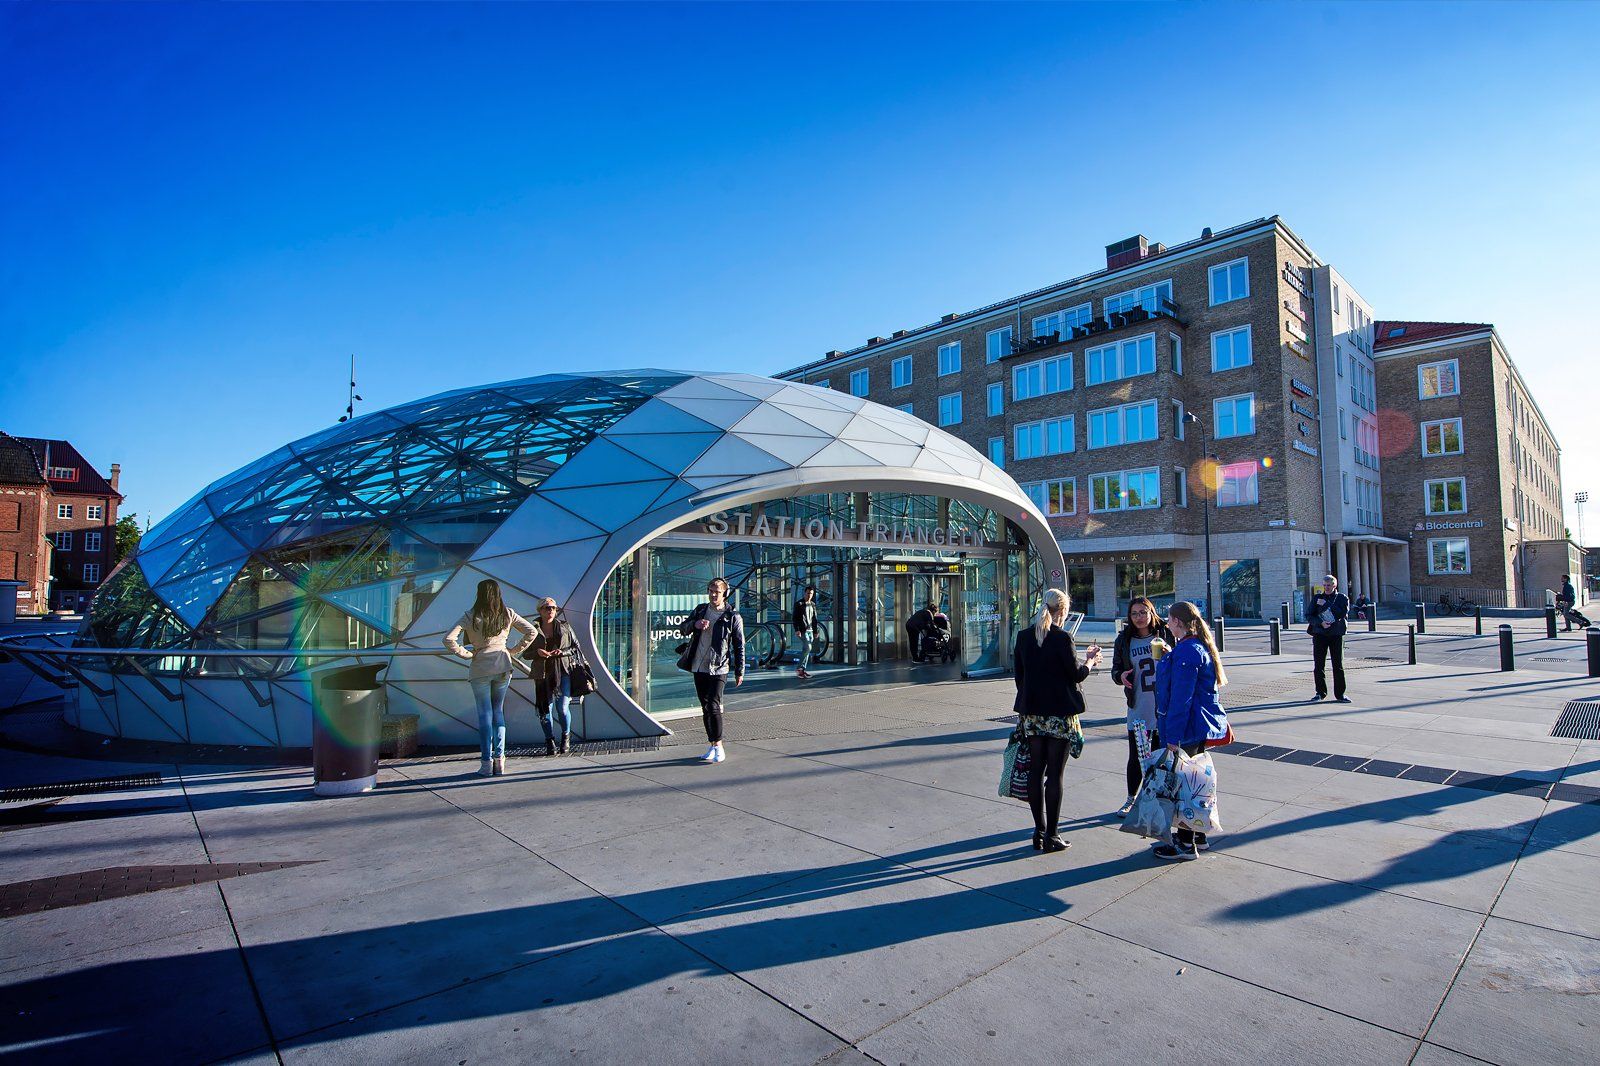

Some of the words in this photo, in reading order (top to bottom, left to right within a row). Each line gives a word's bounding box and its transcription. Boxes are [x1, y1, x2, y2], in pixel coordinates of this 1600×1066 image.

[708, 511, 844, 541] STATION
[857, 521, 984, 548] TRIANGELN
[1425, 519, 1484, 531] Blodcentral
